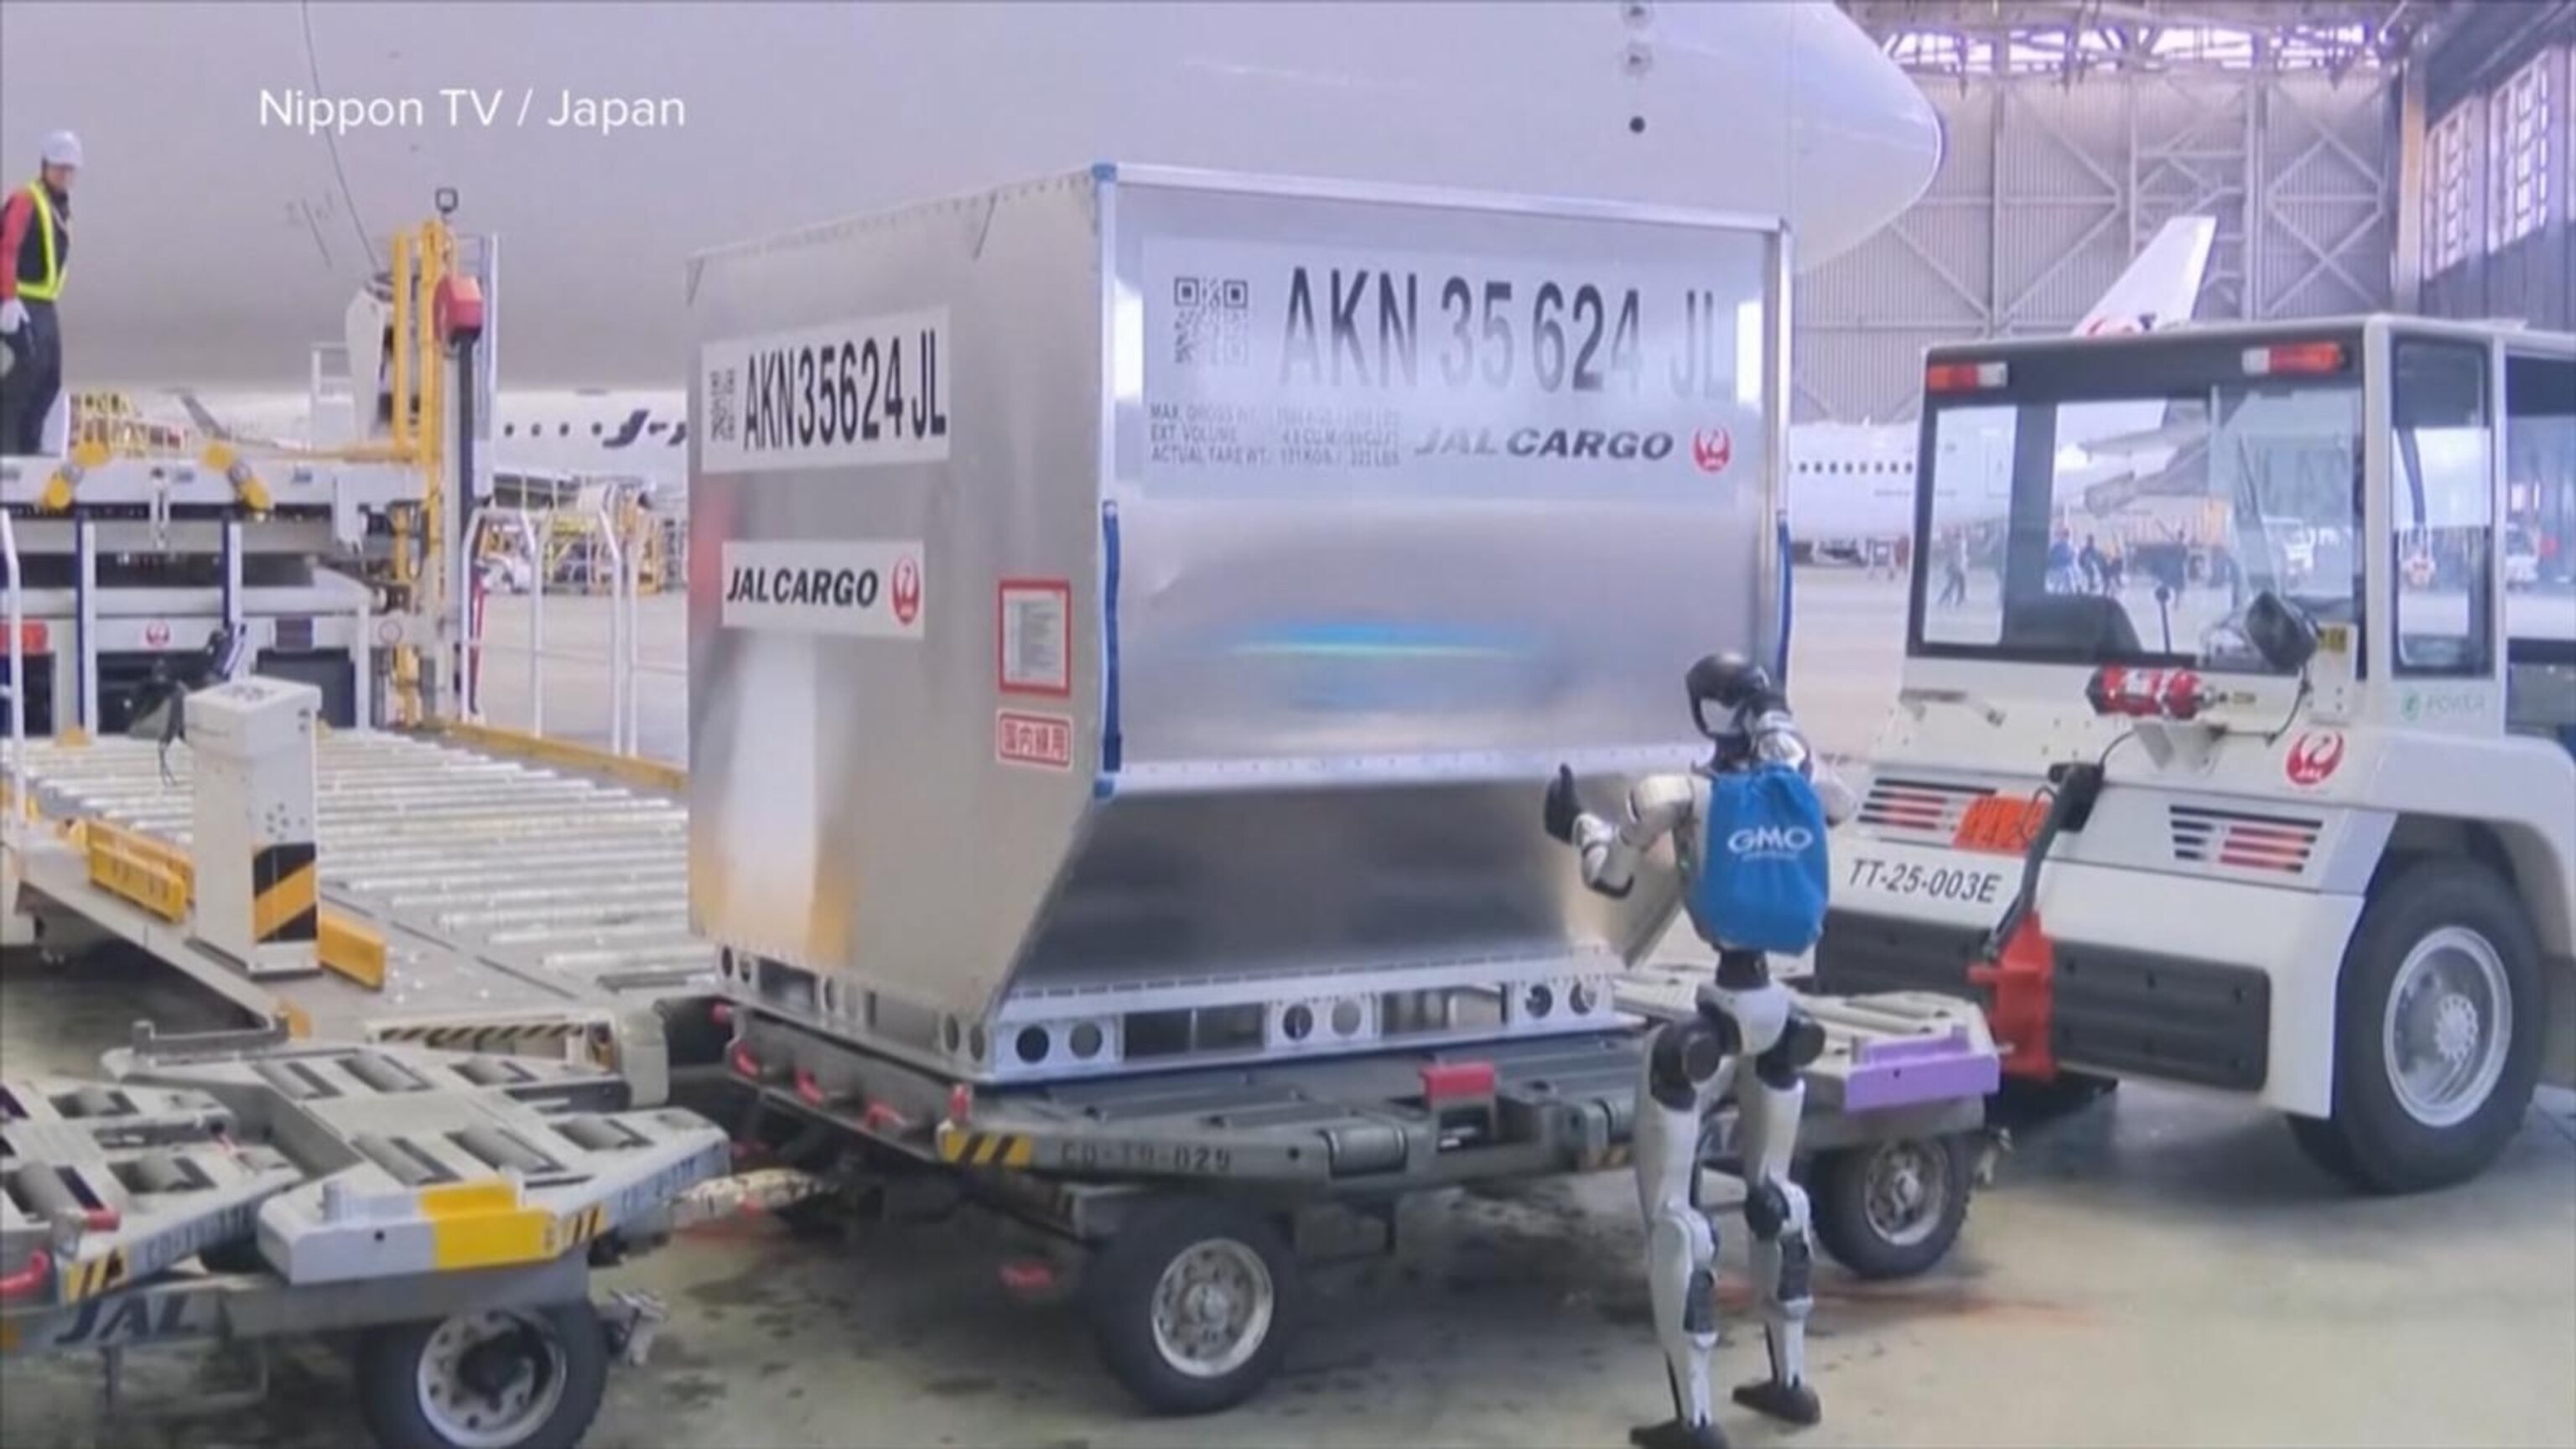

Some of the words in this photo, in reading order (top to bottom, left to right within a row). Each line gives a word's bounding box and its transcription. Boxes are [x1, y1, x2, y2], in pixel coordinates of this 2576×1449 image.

[1280, 267, 1417, 387] AKN
[744, 337, 904, 451] AKN35624
[911, 330, 947, 439] JL
[1506, 428, 1674, 460] CARGO
[1727, 826, 1814, 854] GMO
[1849, 859, 2002, 904] TT-25-003E
[55, 1294, 200, 1345] JAL
